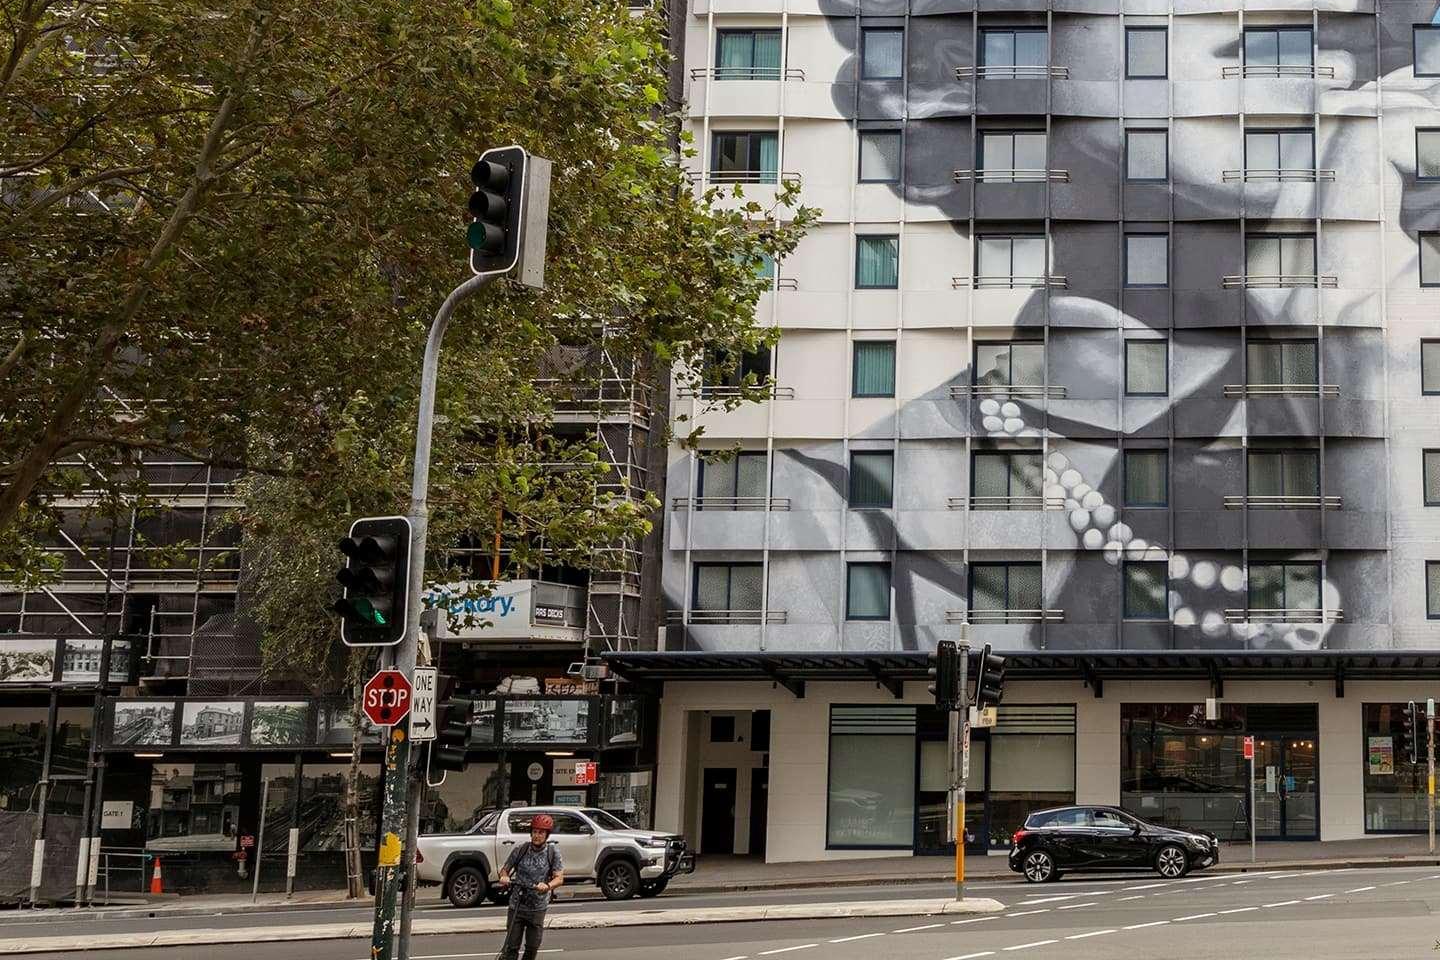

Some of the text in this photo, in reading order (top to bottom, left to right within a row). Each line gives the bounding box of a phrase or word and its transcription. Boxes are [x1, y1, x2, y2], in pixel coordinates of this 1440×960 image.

[429, 593, 516, 617] ckory.
[415, 675, 433, 691] ONE
[367, 688, 408, 708] STOP
[413, 697, 433, 713] WAY
